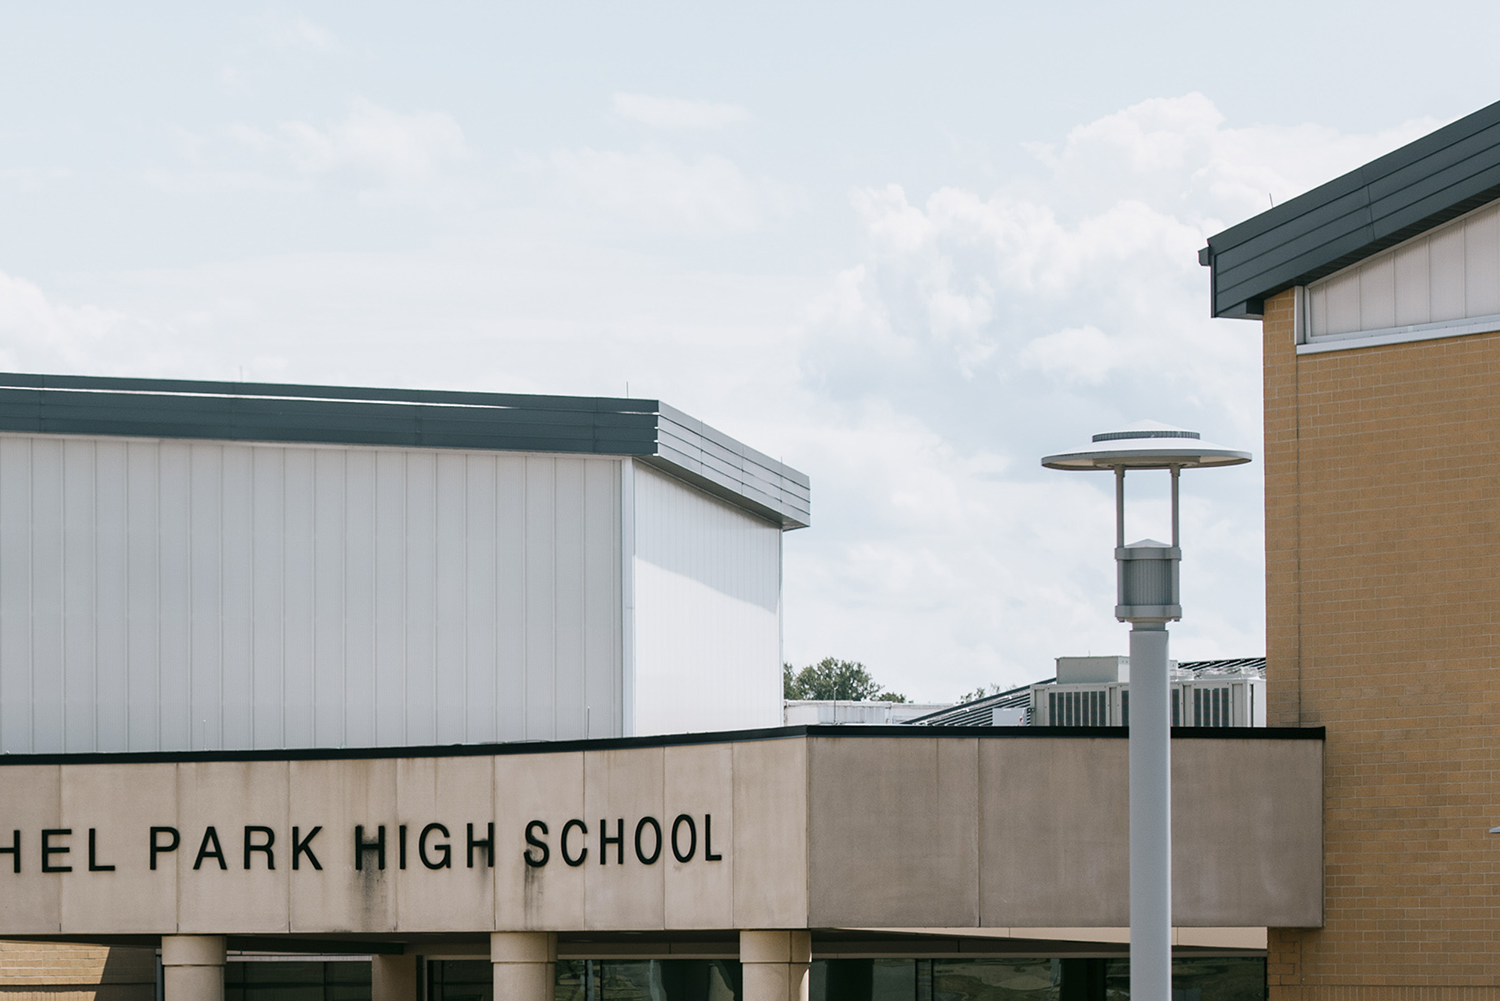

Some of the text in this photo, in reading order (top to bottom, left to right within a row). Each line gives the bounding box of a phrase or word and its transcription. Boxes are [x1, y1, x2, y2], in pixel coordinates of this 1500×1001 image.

[149, 825, 323, 871] PARK
[354, 822, 495, 871] HIGH
[523, 813, 722, 869] SCHOOL
